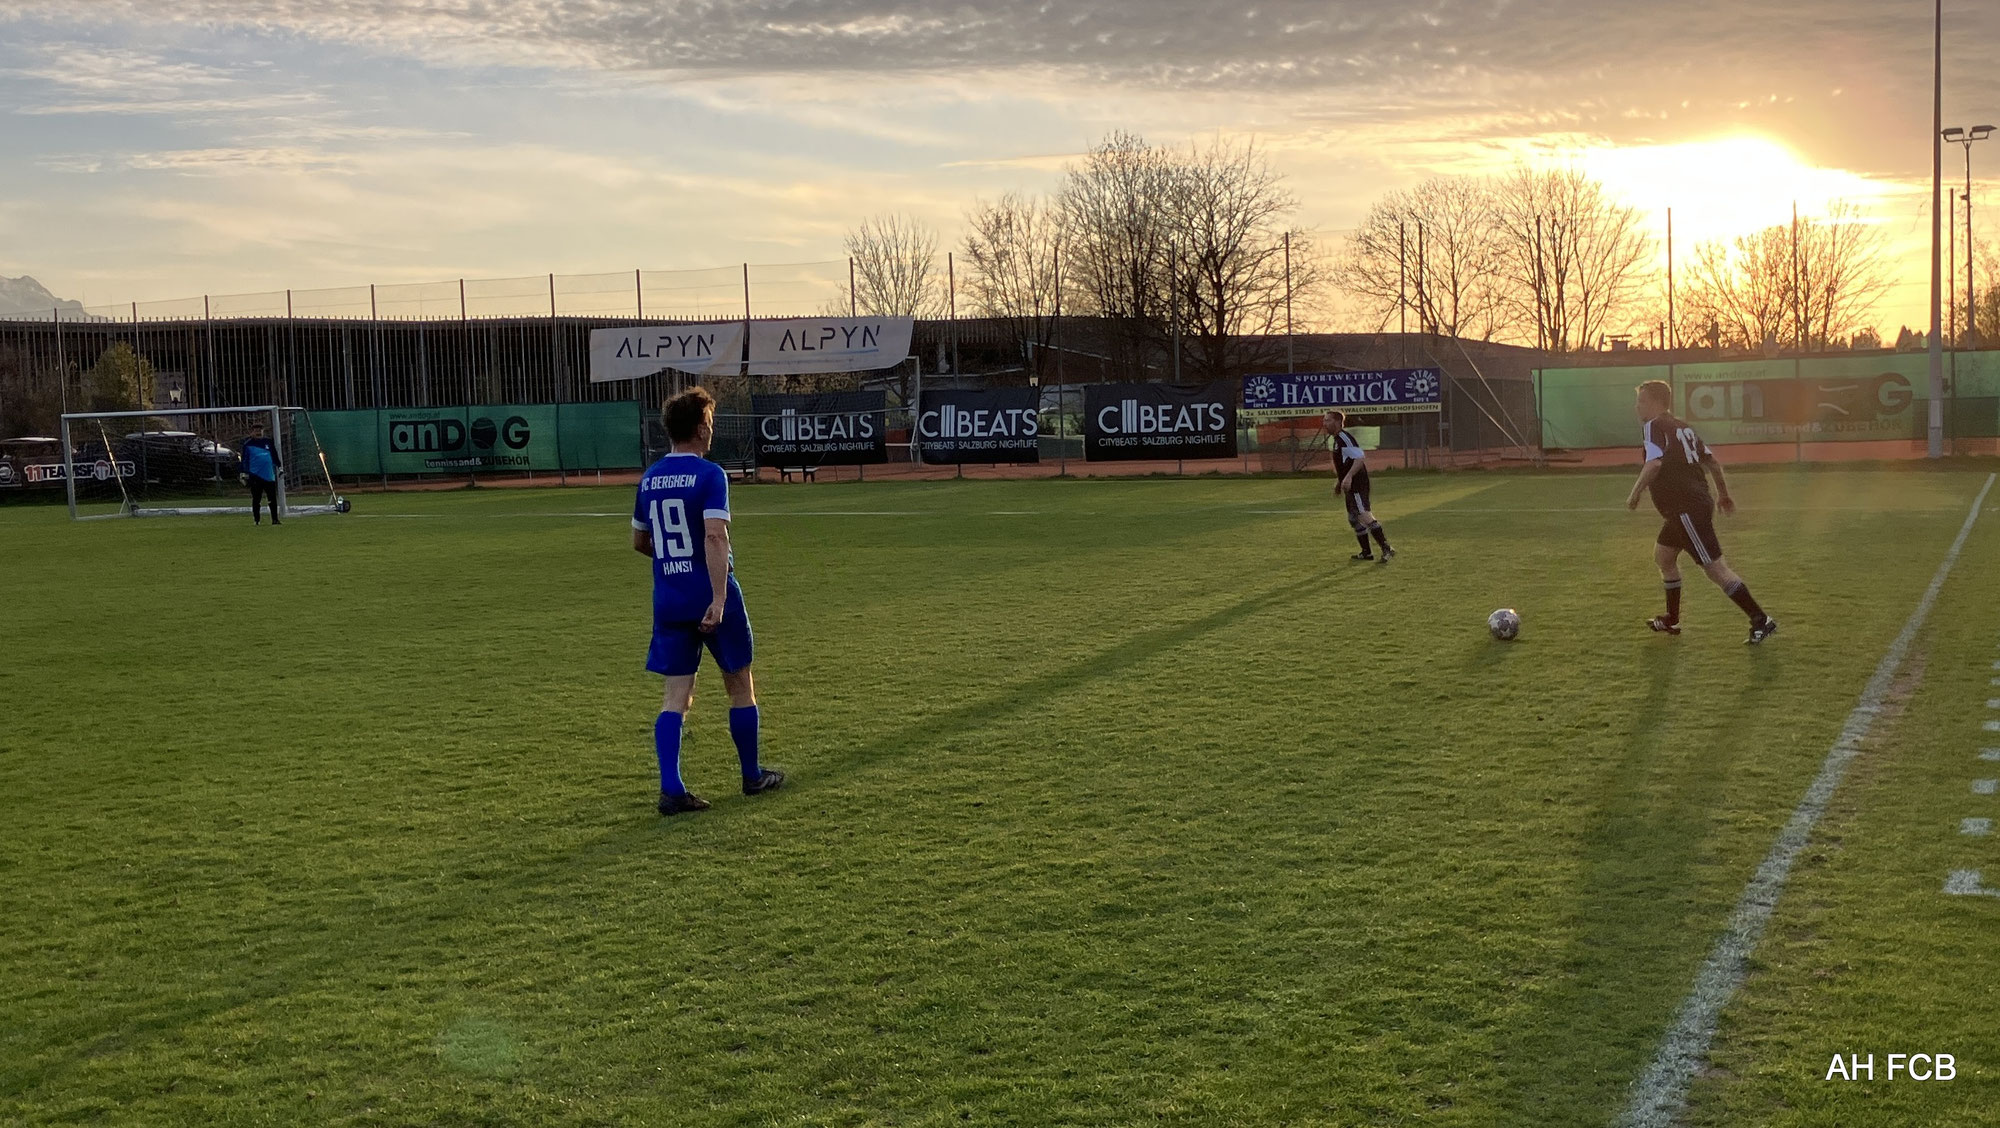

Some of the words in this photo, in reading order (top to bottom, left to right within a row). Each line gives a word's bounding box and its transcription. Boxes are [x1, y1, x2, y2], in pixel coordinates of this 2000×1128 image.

[616, 333, 714, 358] ALPYN
[778, 325, 880, 352] ALPYN
[1295, 372, 1383, 382] SPORTWETTEN
[1281, 378, 1398, 405] HATTRICK
[1383, 404, 1439, 412] BISCHOFSHOFEN
[762, 444, 797, 453] CITYBEATS
[800, 442, 838, 453] SALZBURG
[839, 441, 874, 451] NIGHTLIFE
[958, 440, 997, 449] SALZBURG
[999, 439, 1038, 449] NIGHTLIFE
[1098, 437, 1138, 447] CITYBEATS
[1142, 435, 1183, 445] SALZBURG
[1185, 434, 1226, 444] NIGHTLIFE
[651, 474, 697, 490] BERGHEIM
[649, 498, 694, 560] 19
[663, 560, 693, 576] HANSI
